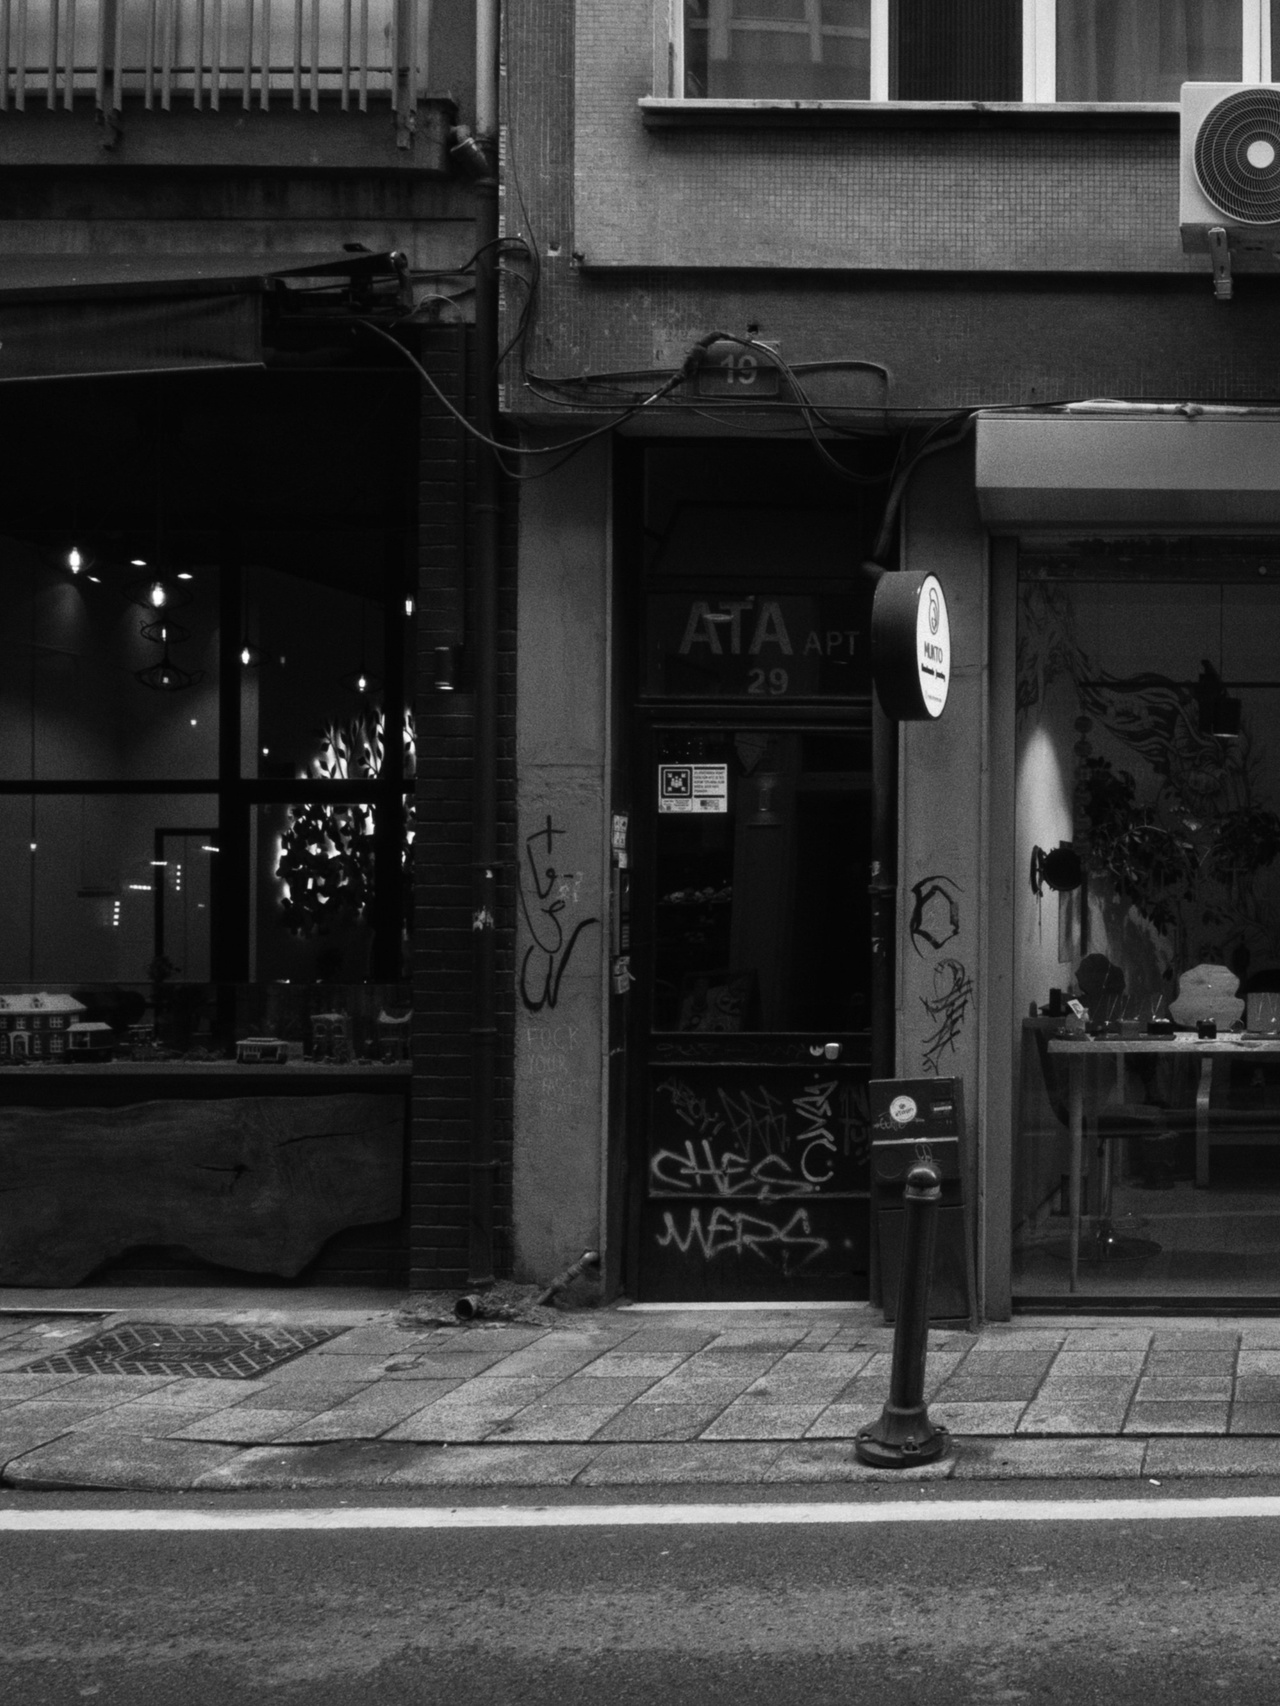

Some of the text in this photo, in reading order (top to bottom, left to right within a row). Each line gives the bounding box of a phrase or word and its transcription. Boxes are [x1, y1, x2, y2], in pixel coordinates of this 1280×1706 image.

[720, 354, 758, 385] 19
[678, 601, 860, 655] ATA APT
[747, 668, 789, 695] 29
